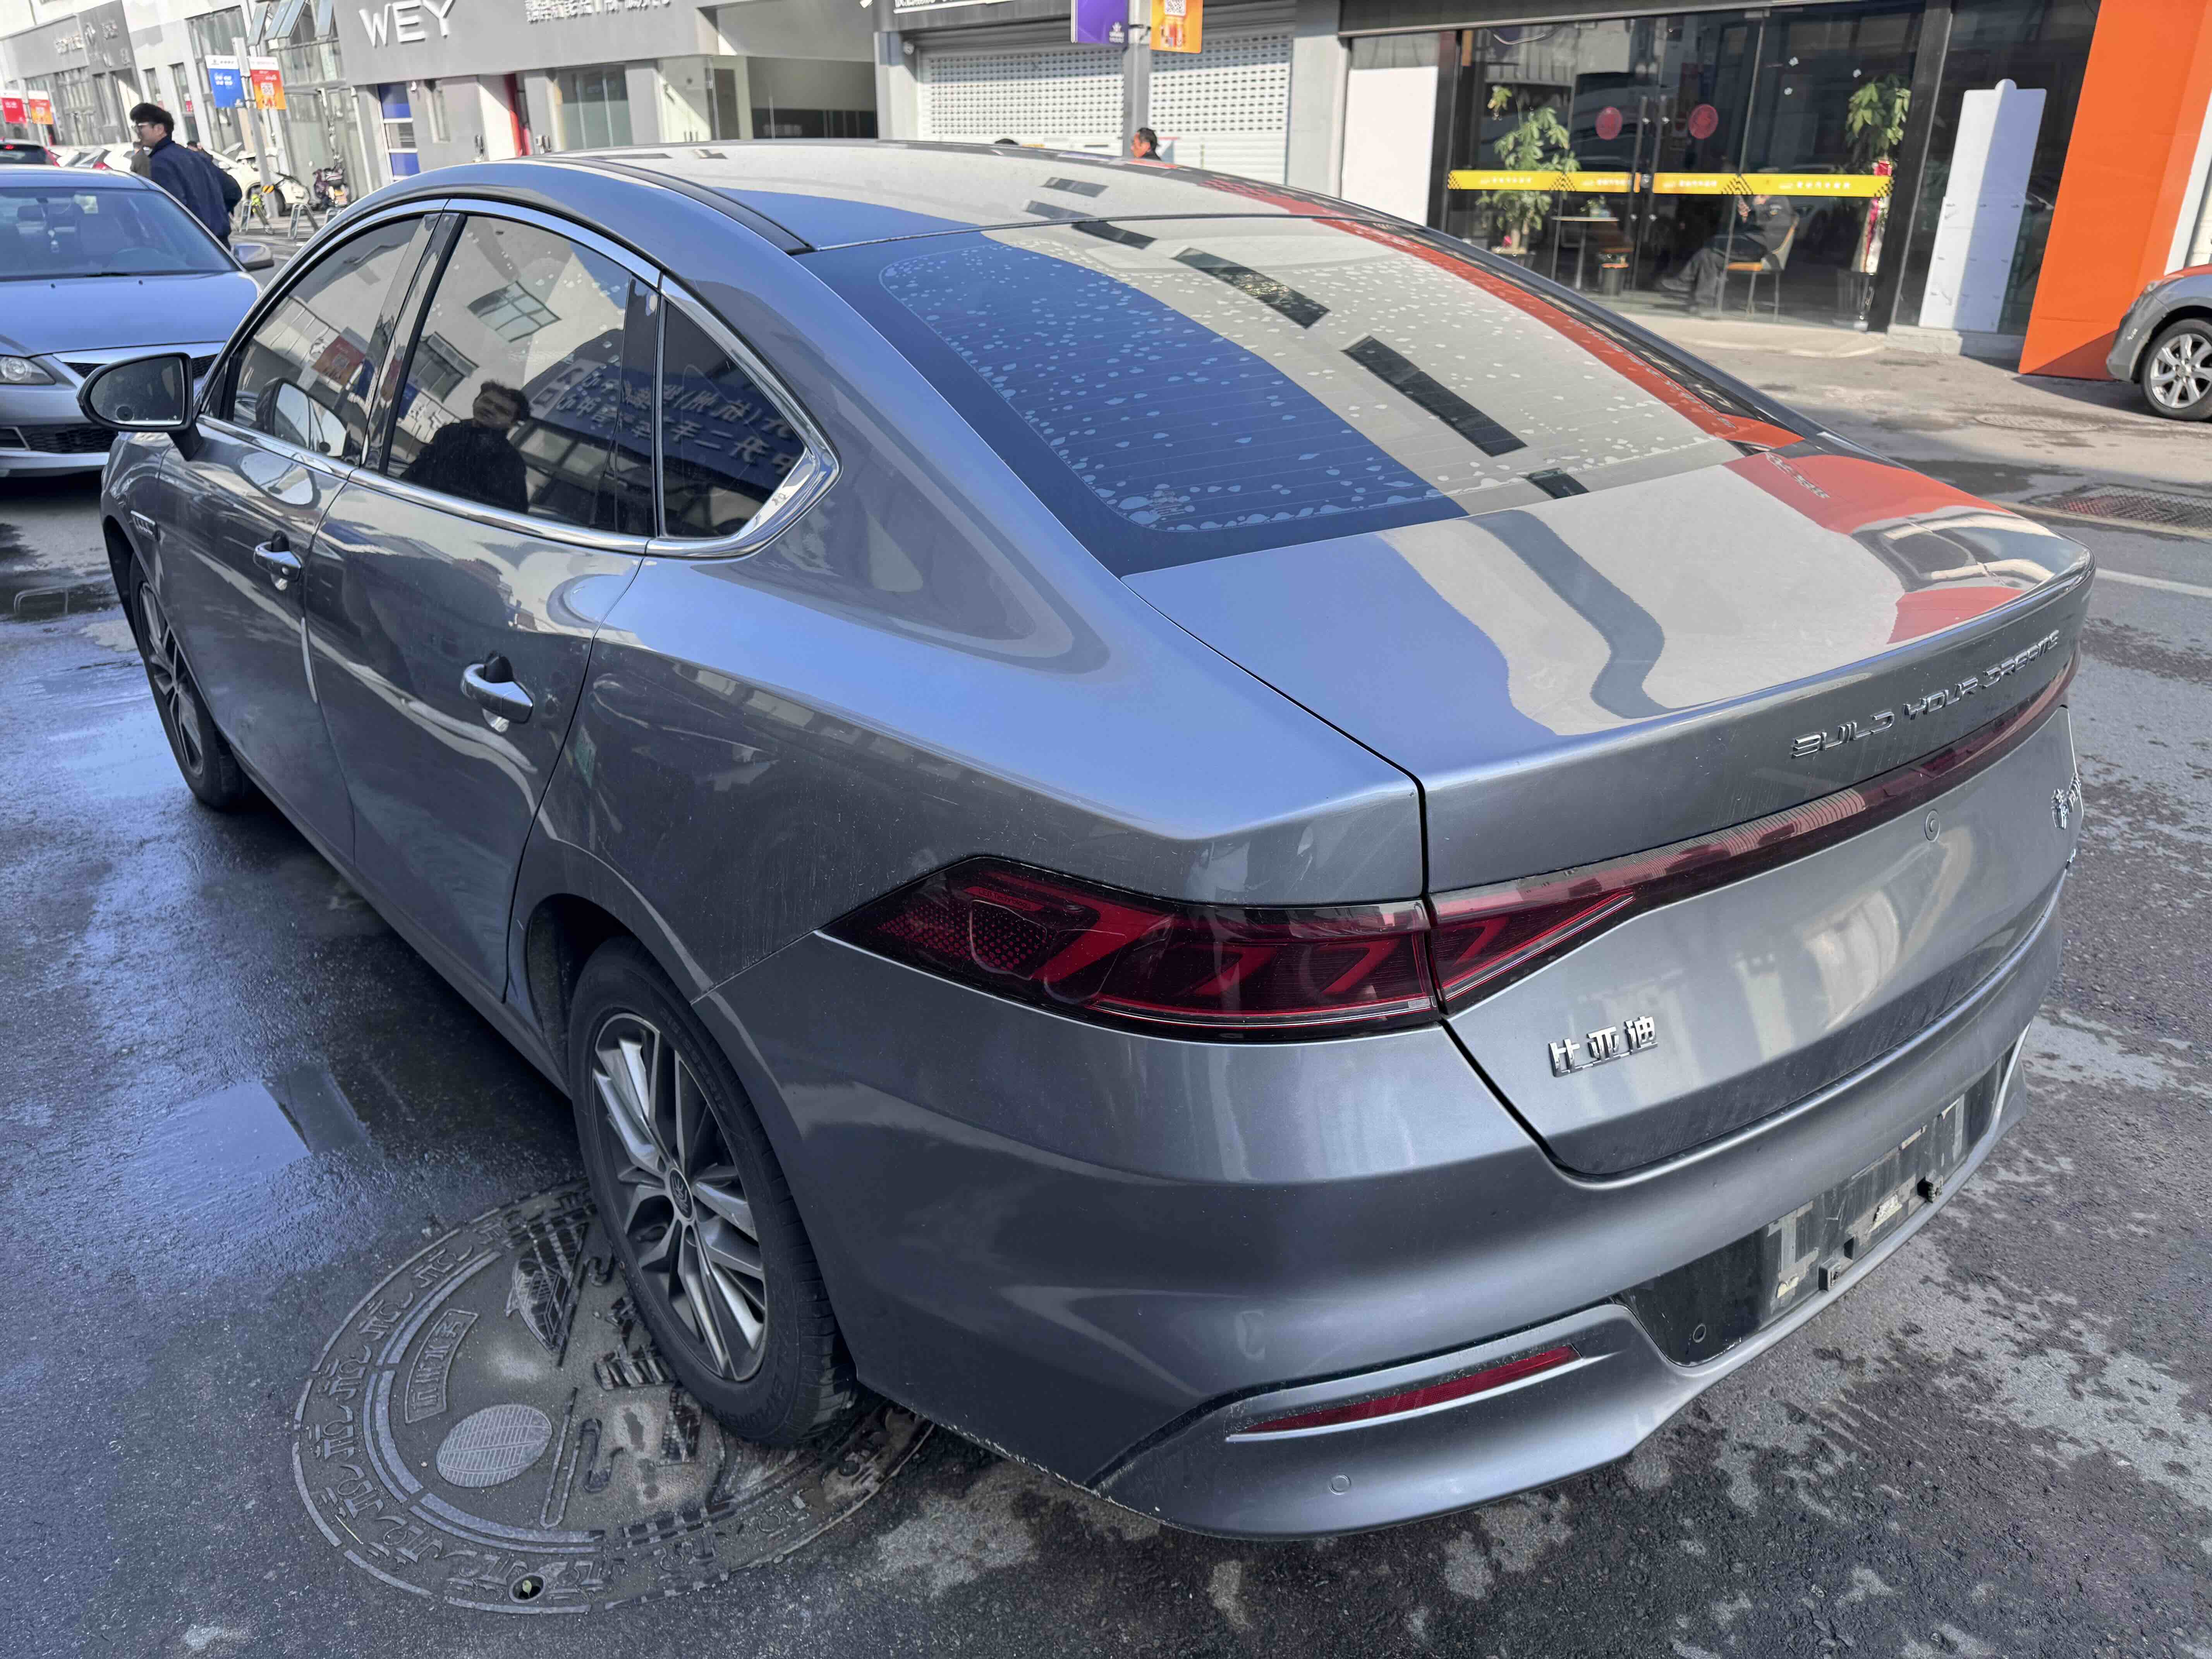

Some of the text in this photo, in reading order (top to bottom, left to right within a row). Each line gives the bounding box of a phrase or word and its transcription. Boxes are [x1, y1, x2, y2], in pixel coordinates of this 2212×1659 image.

[359, 0, 456, 48] WEY
[1791, 708, 1895, 759] BUILD
[1902, 677, 1978, 720] YOUR
[1548, 1015, 1658, 1078] 比亚迪
